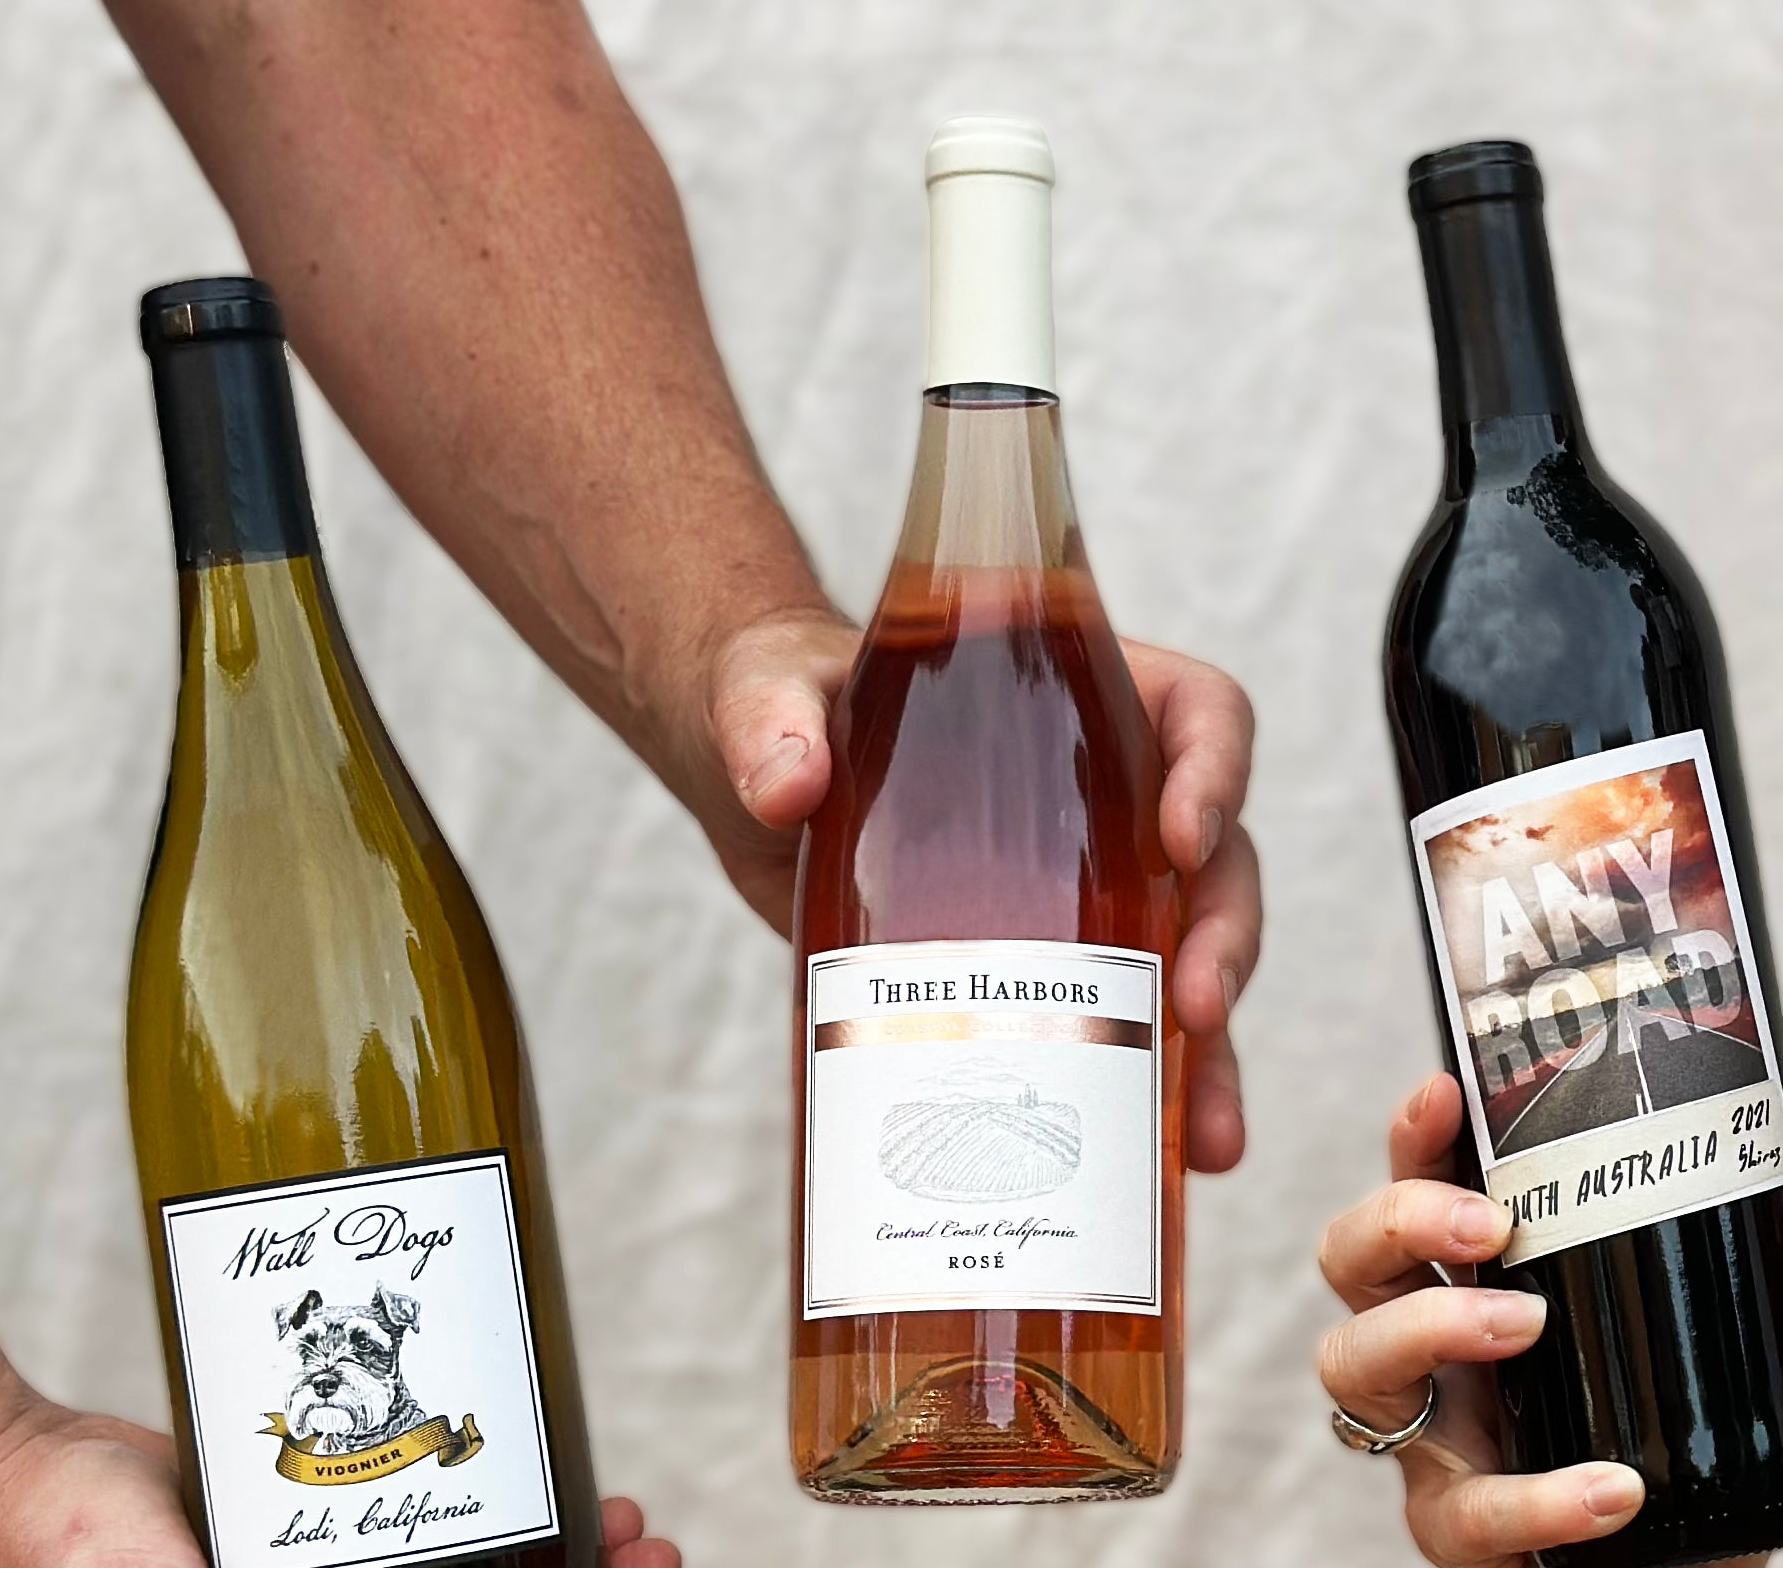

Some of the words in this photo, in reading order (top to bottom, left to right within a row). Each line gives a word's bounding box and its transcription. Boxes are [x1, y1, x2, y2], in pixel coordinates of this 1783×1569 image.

[1481, 829, 1678, 985] ANY
[869, 977, 957, 1005] THREE
[968, 974, 1100, 1005] HARBORS
[1467, 929, 1743, 1097] ROAD
[1731, 1098, 1770, 1135] 2021
[1503, 1180, 1560, 1228] OUTH
[1577, 1130, 1718, 1202] AUSTRALIA
[222, 1207, 330, 1281] Wall
[333, 1204, 454, 1281] Dogs
[876, 1222, 938, 1241] Central
[993, 1216, 1078, 1250] California
[948, 1251, 1005, 1269] ROSÉ
[315, 1448, 403, 1478] VIOGNIER
[269, 1507, 339, 1549] Lodi,
[353, 1491, 486, 1544] California
